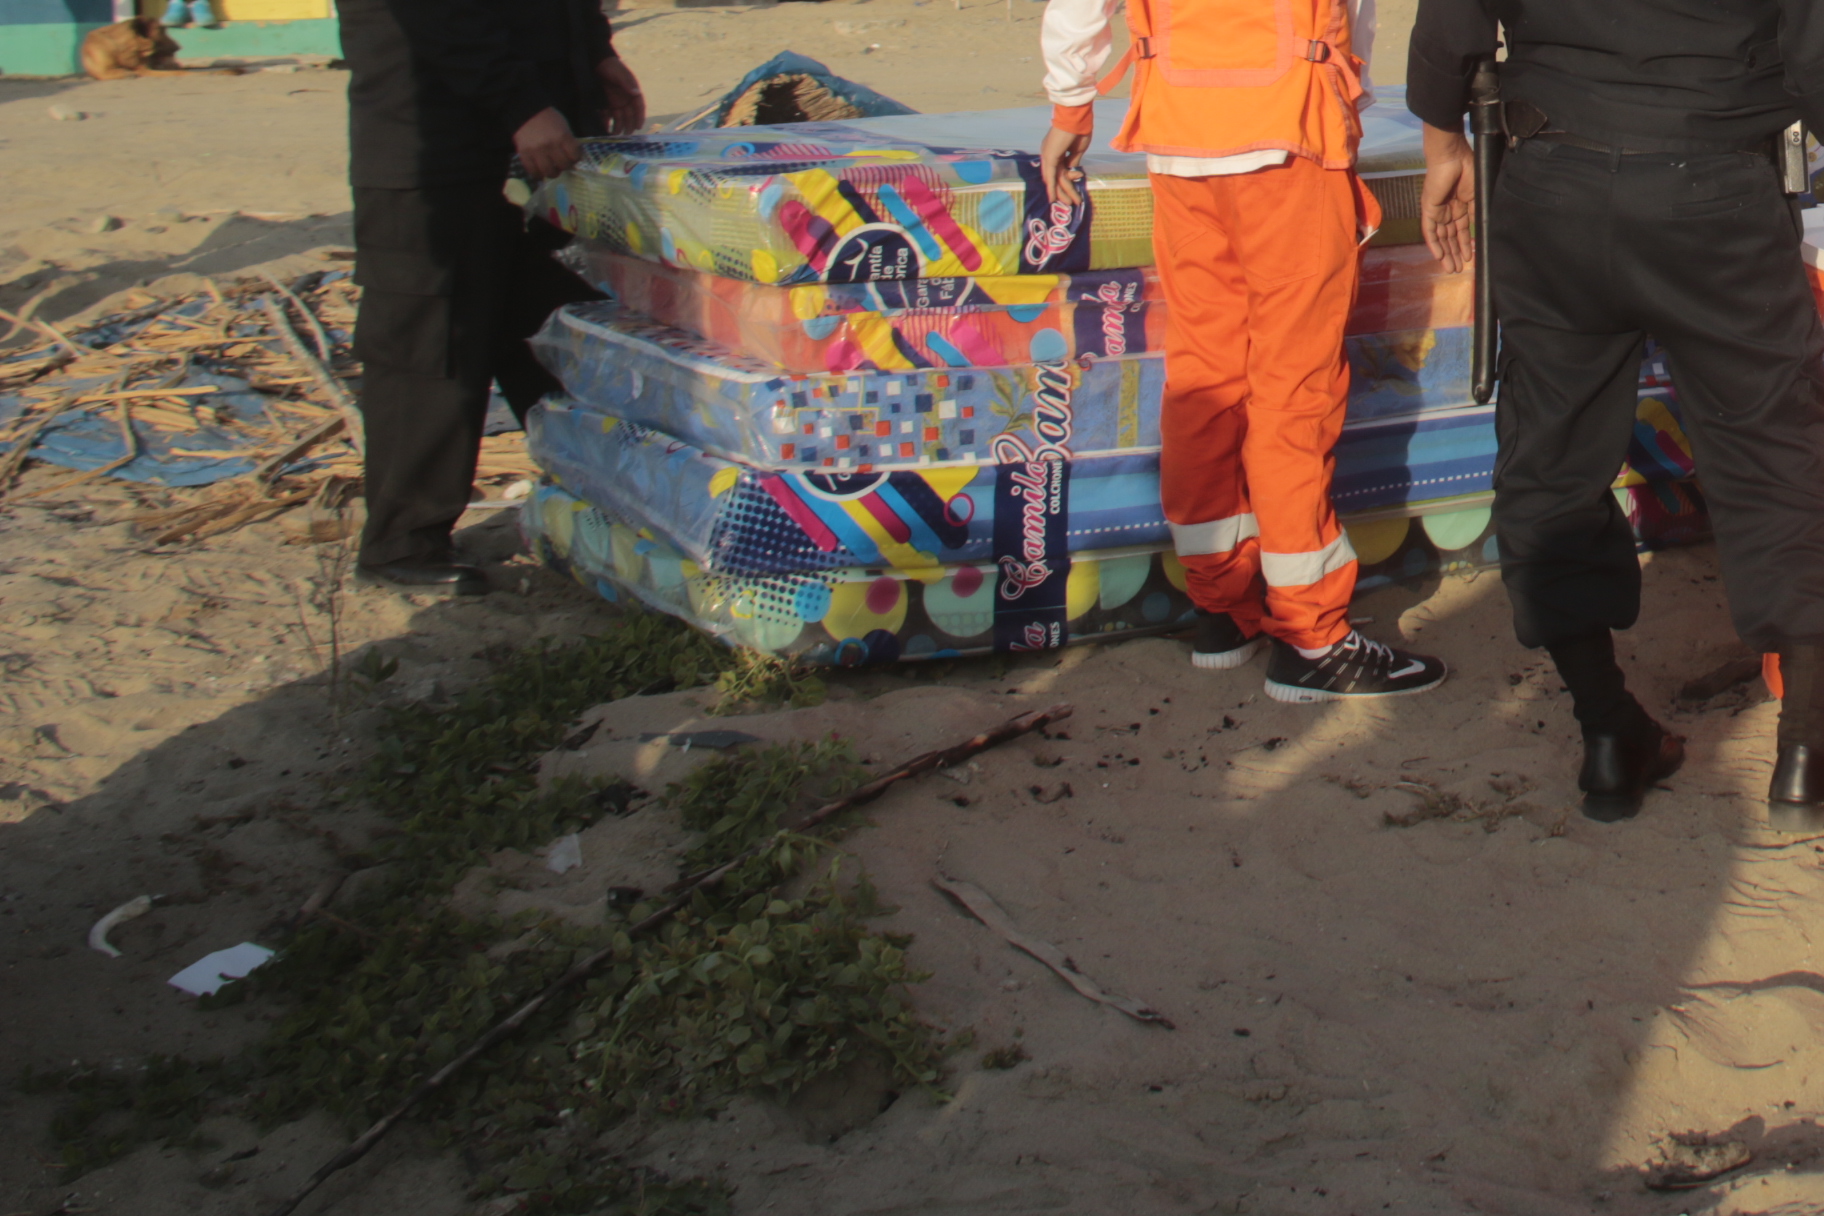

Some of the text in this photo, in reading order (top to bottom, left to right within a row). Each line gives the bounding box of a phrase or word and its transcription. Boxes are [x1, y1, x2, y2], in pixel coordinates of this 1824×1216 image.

[868, 245, 883, 281] antía
[895, 247, 909, 281] rica
[1050, 460, 1062, 515] COLCHONE
